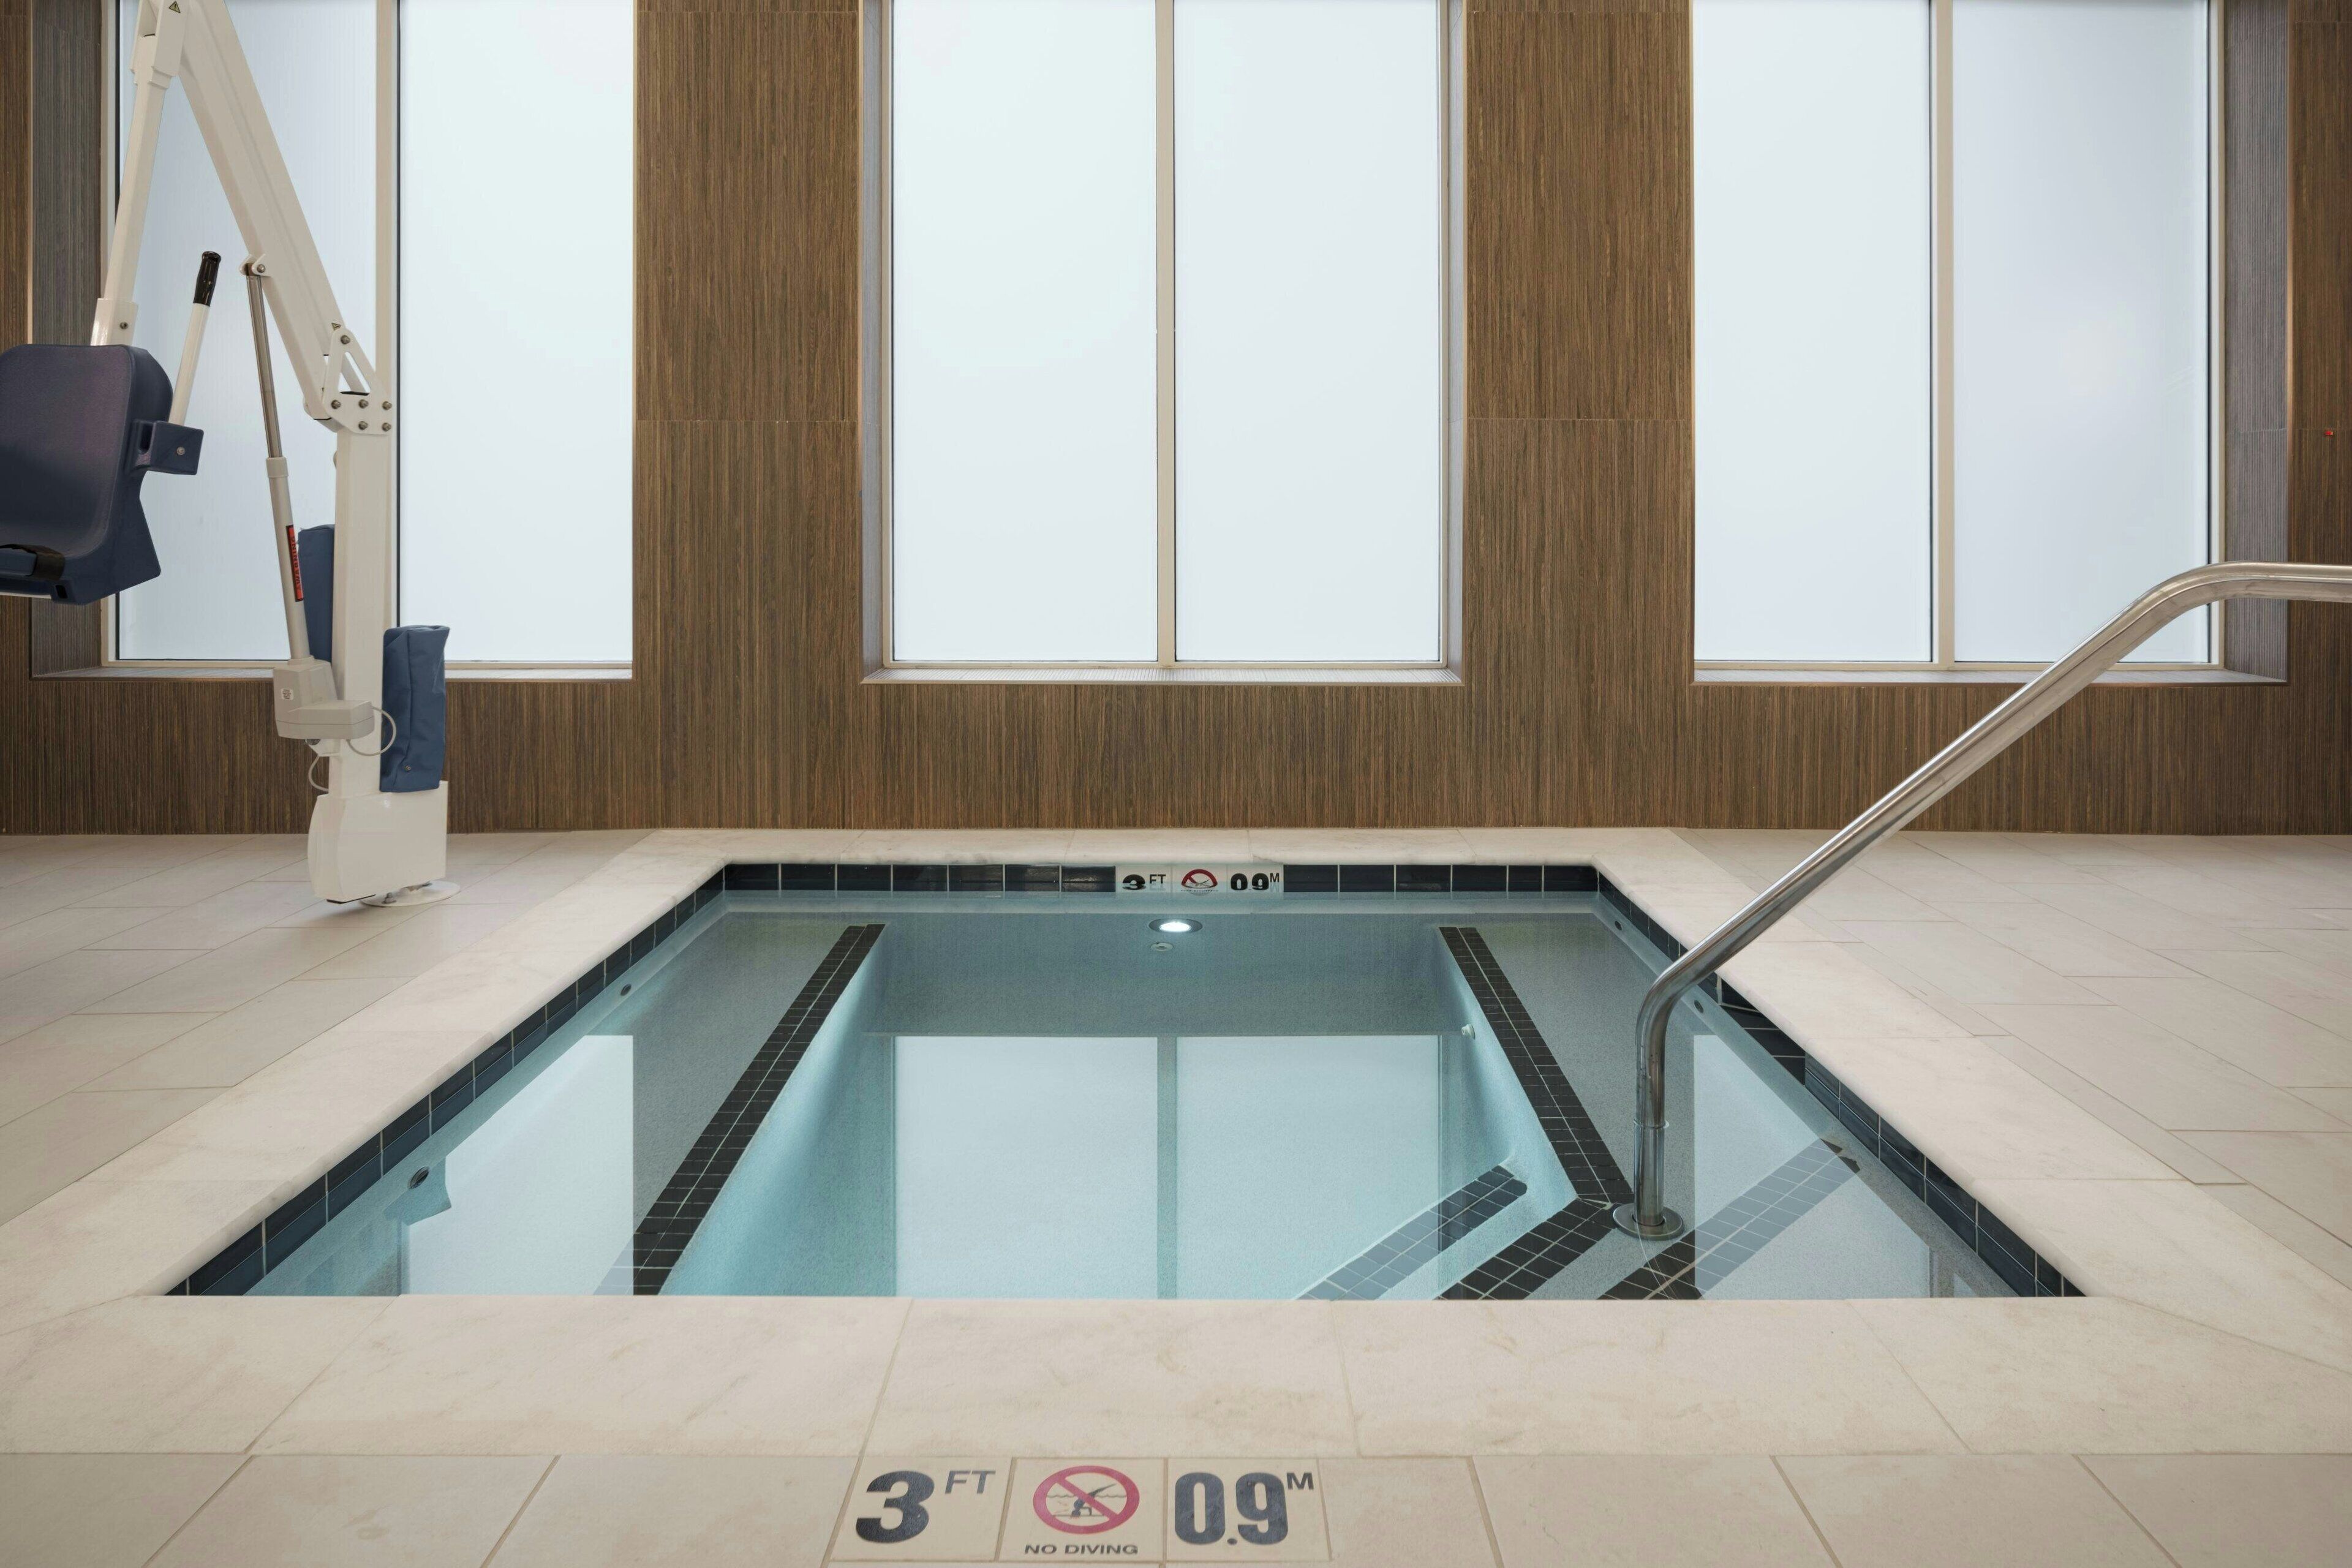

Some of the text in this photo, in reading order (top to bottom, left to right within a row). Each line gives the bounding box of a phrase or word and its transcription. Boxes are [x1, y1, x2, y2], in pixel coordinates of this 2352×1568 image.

[291, 537, 300, 584] WARNING
[1149, 873, 1166, 884] FT
[1270, 873, 1280, 883] M
[856, 1471, 996, 1544] 3 FT
[1175, 1472, 1314, 1545] 0.9 M
[1025, 1544, 1138, 1555] NO DIVING
